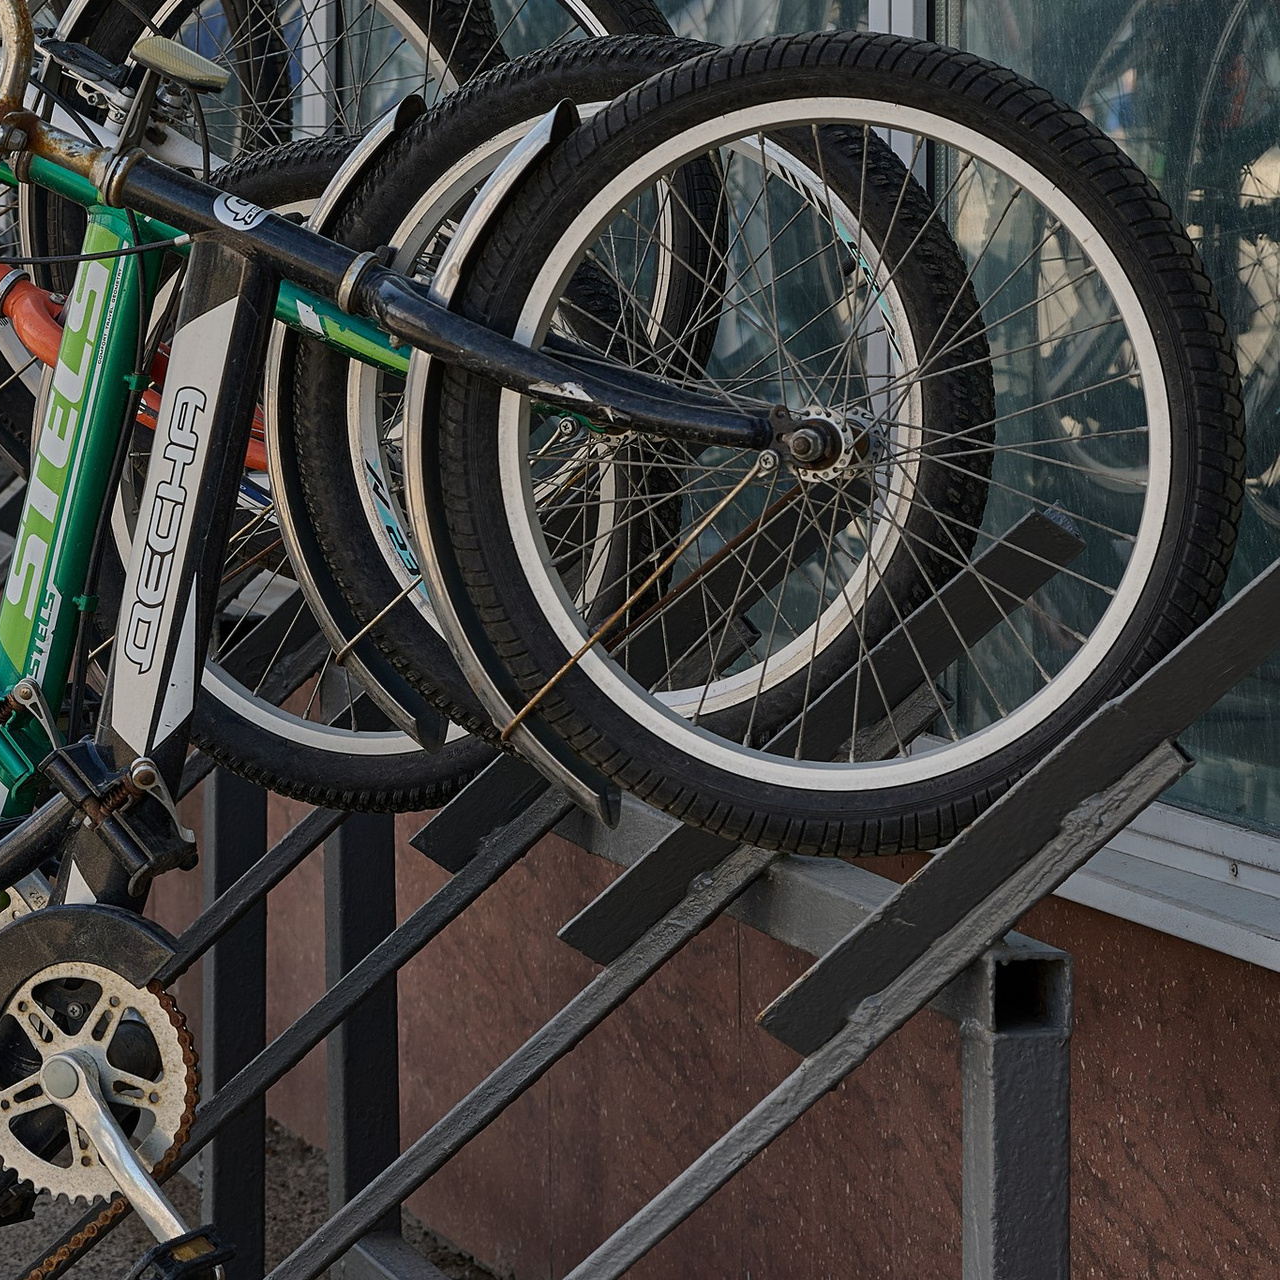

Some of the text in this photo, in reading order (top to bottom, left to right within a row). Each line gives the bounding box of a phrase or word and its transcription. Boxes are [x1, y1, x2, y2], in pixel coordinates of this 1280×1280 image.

[105, 307, 114, 330] TRAVEL
[111, 268, 122, 303] GEOMETRY
[6, 259, 111, 620] STELS
[123, 385, 208, 675] ДЕСНА
[28, 589, 56, 680] STELS
